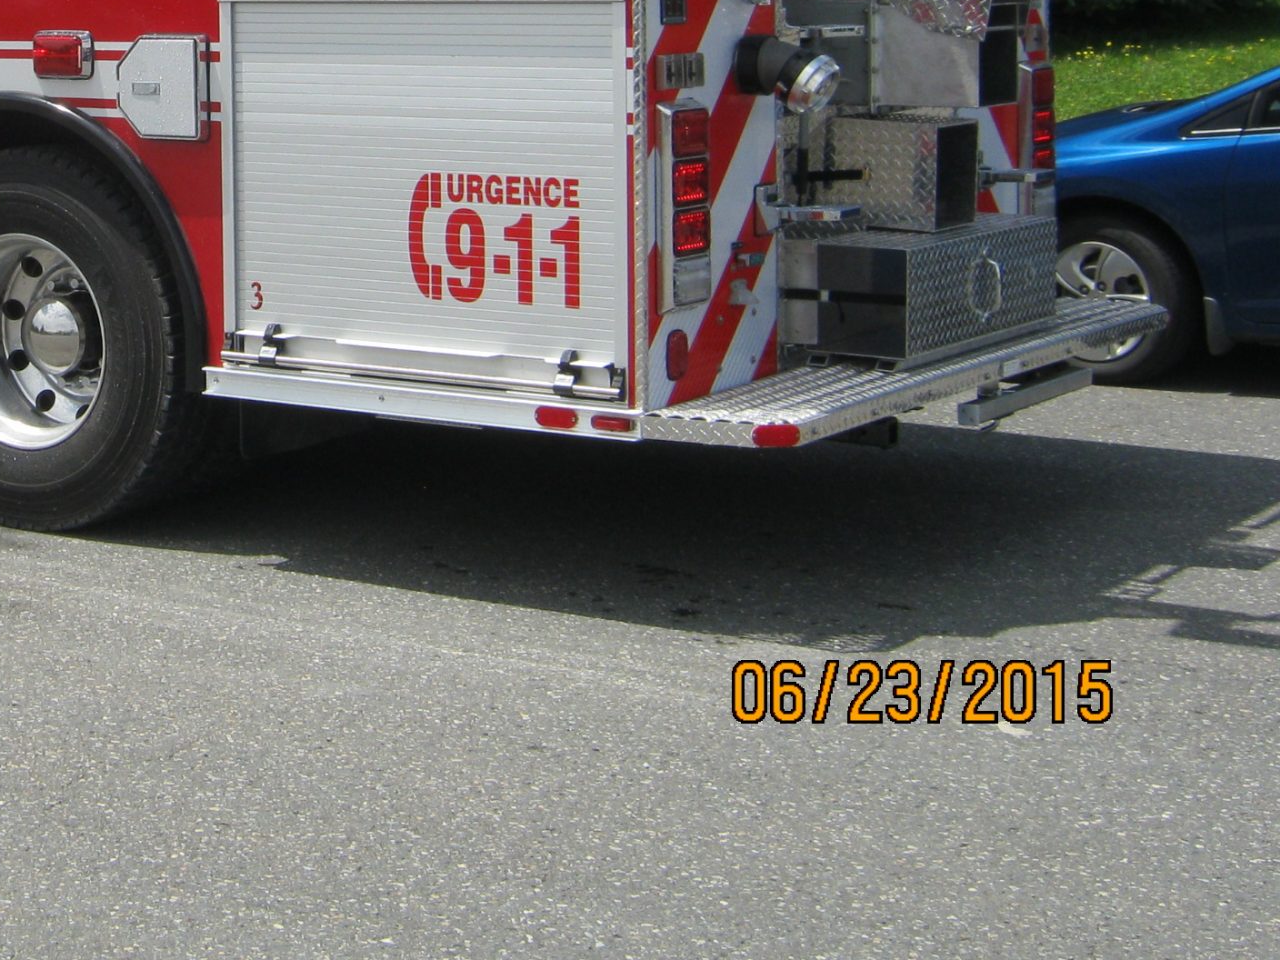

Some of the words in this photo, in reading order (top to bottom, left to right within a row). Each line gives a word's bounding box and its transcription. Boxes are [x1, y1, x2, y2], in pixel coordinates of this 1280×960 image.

[447, 173, 581, 208] URGENCE
[445, 207, 581, 310] 9-1-1
[250, 281, 264, 311] 3
